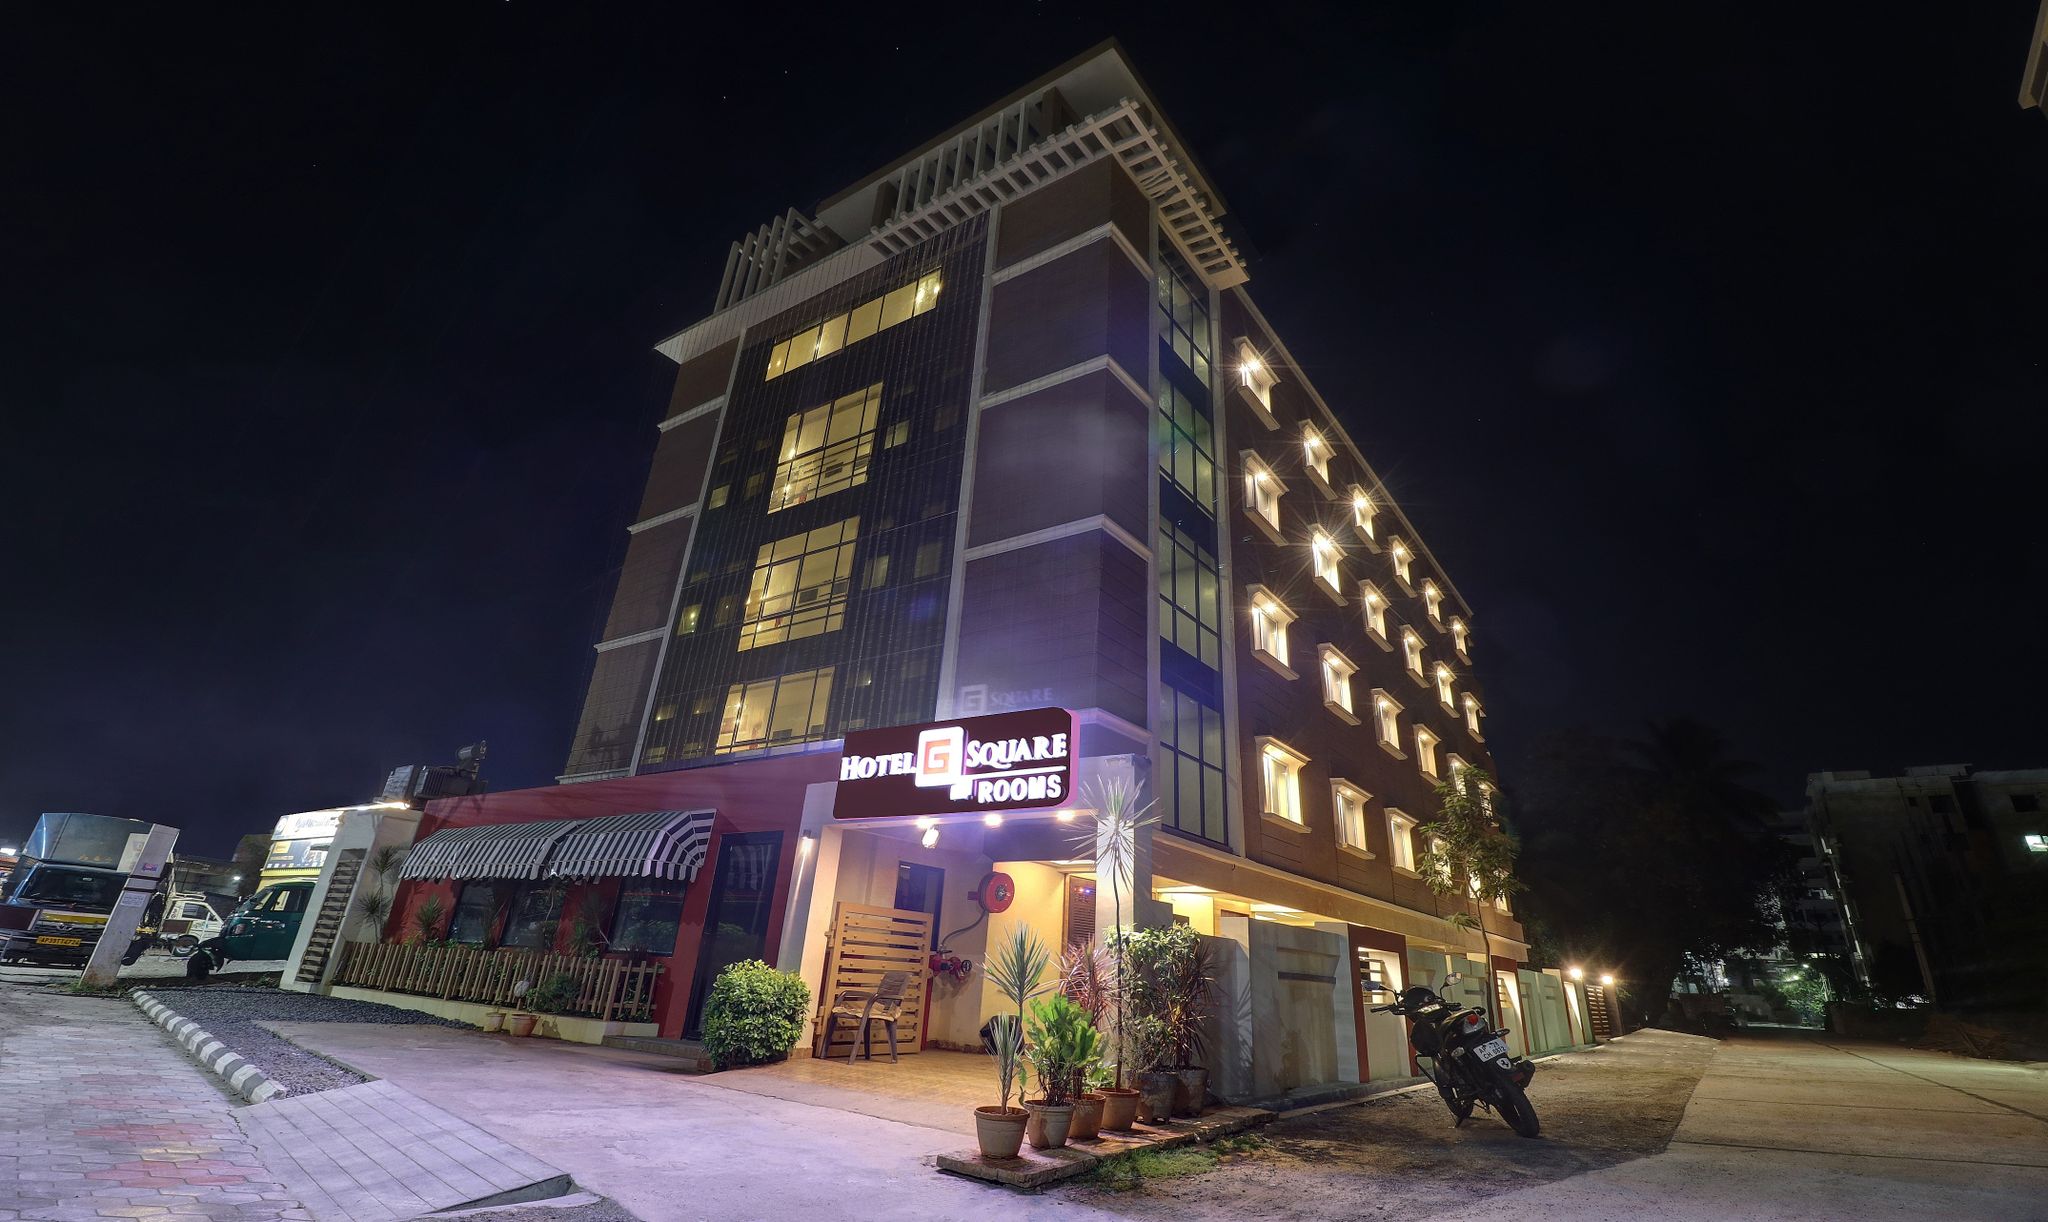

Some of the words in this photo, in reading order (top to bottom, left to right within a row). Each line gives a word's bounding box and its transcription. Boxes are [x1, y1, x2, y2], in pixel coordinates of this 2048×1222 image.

[840, 752, 916, 781] HOTEL
[966, 733, 1068, 769] SQUARE
[978, 774, 1062, 803] ROOMS
